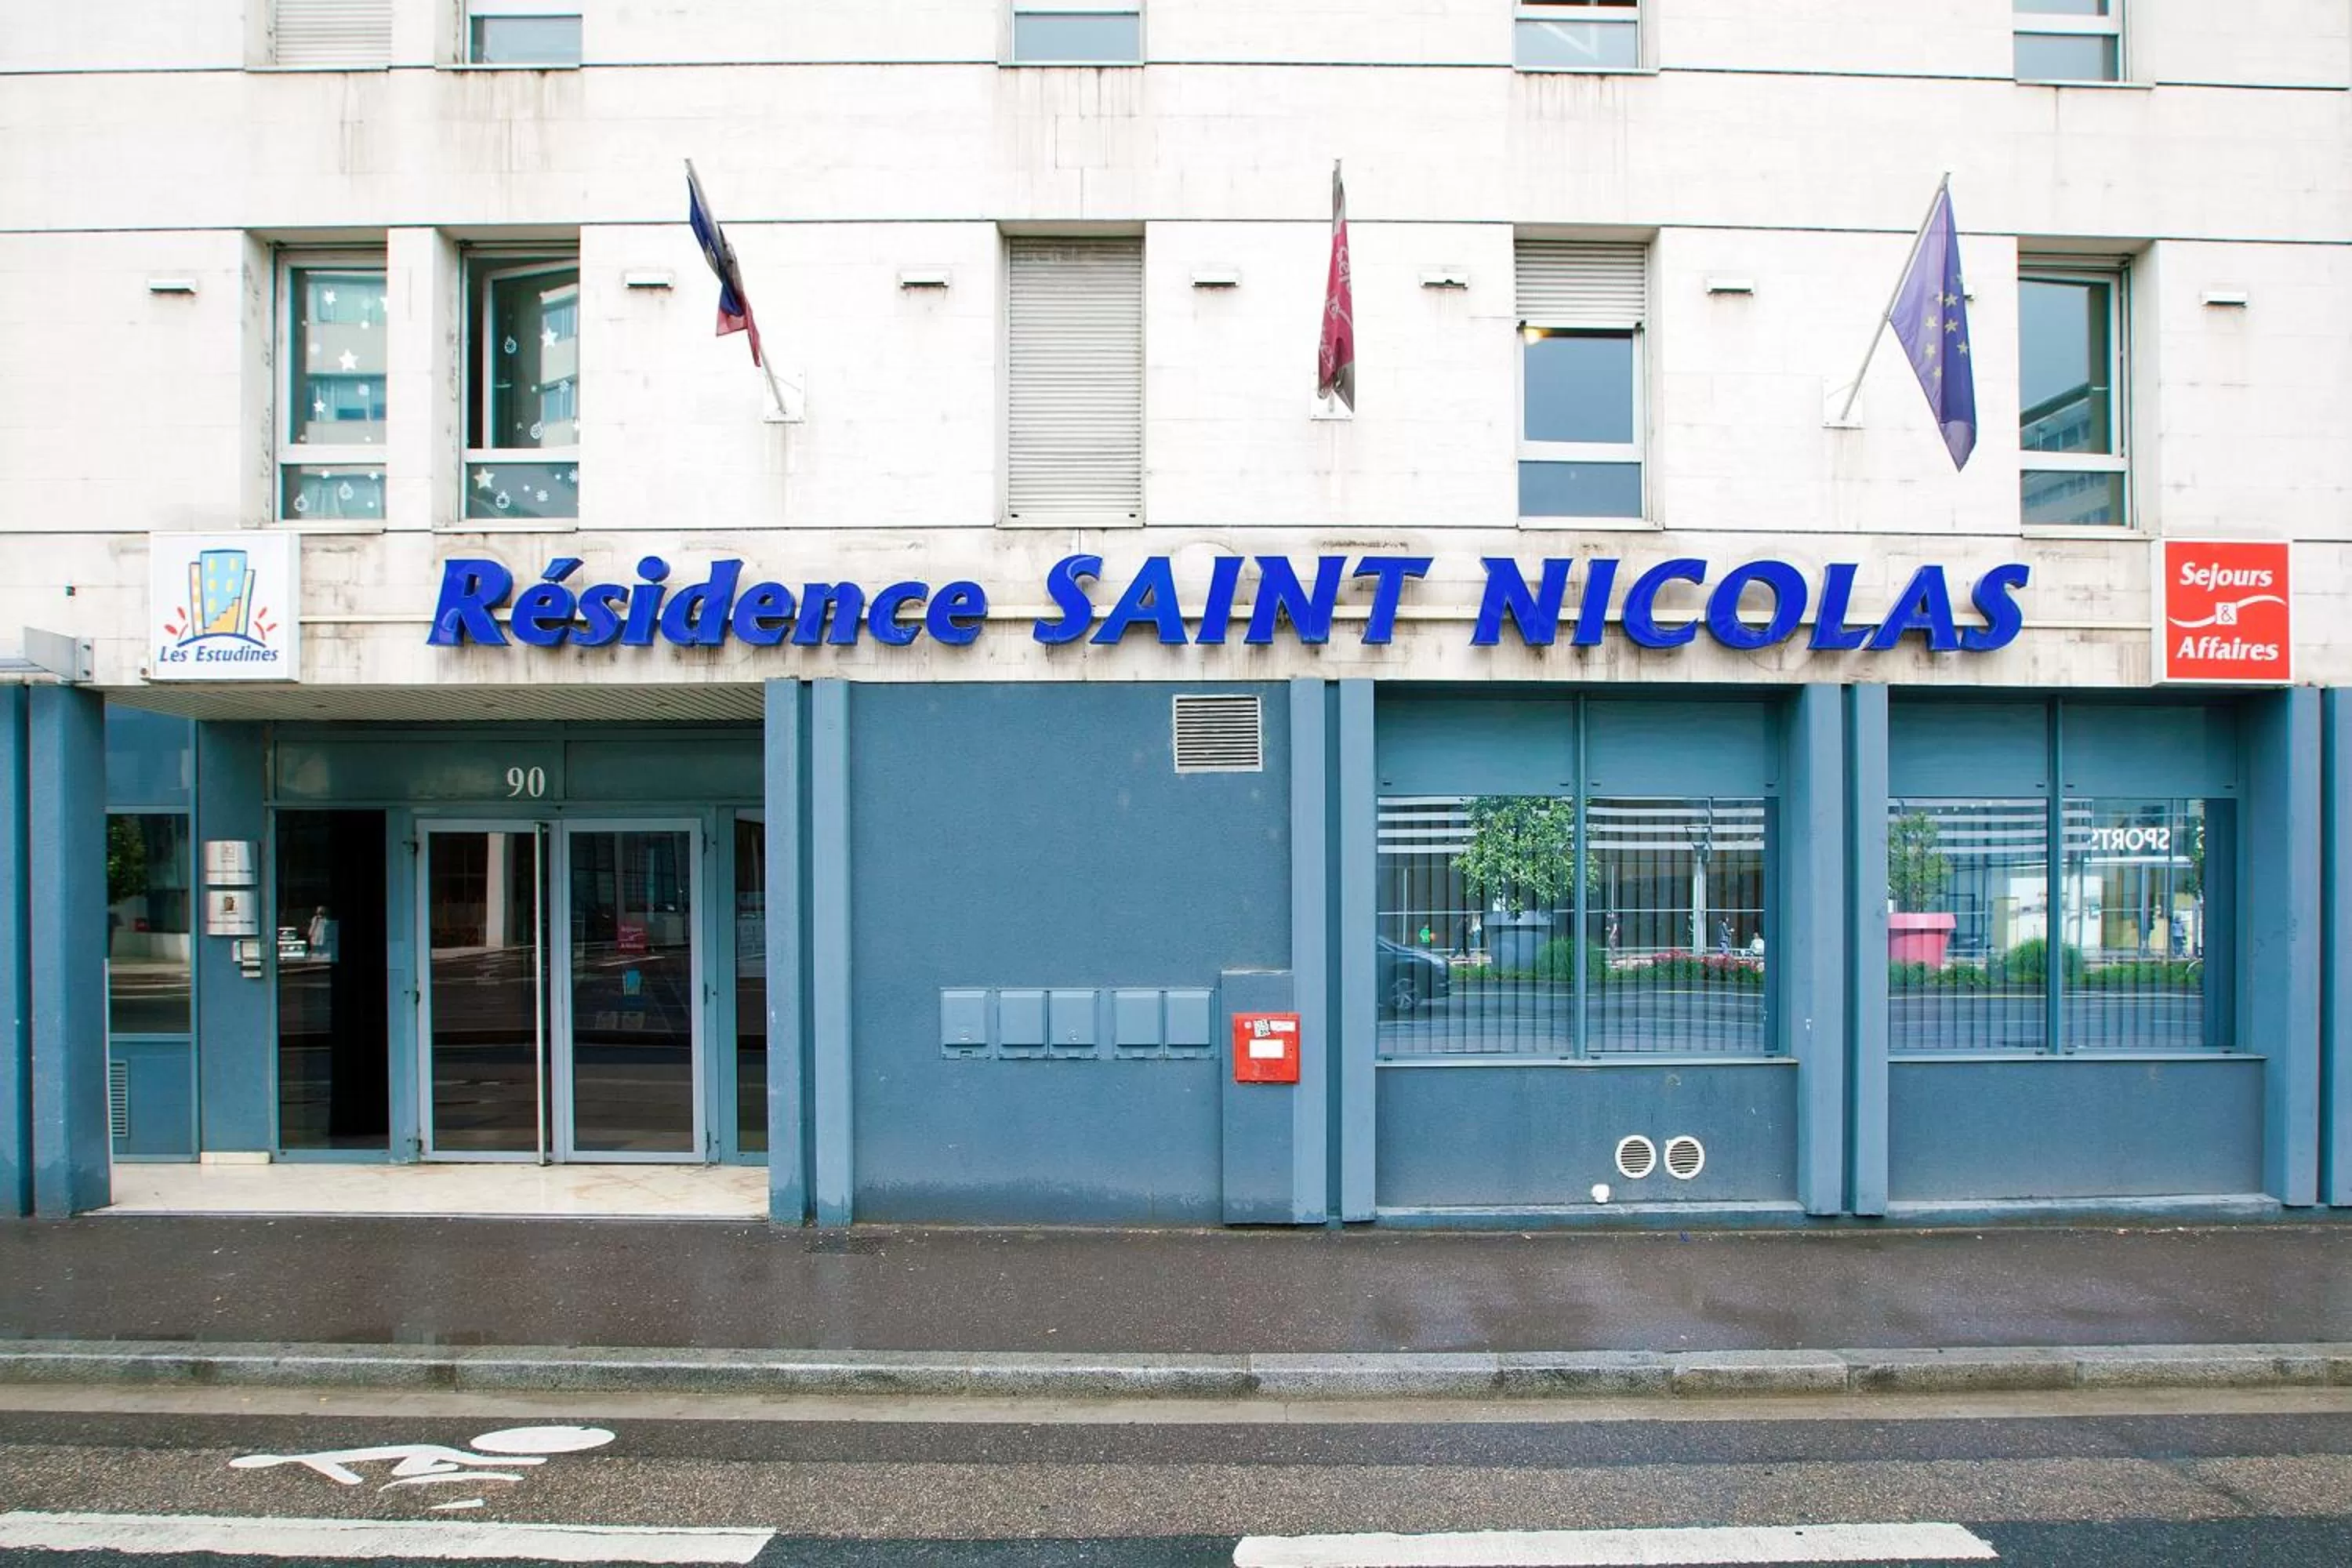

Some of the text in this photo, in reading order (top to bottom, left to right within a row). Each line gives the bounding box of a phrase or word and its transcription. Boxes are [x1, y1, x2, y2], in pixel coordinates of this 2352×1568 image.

[2179, 561, 2274, 593] Sejours
[426, 554, 2031, 652] Résidence SAINT NICOLAS
[2220, 604, 2234, 623] &
[158, 644, 280, 662] Les Estudines
[2175, 635, 2280, 662] Affaires
[506, 766, 546, 797] 90
